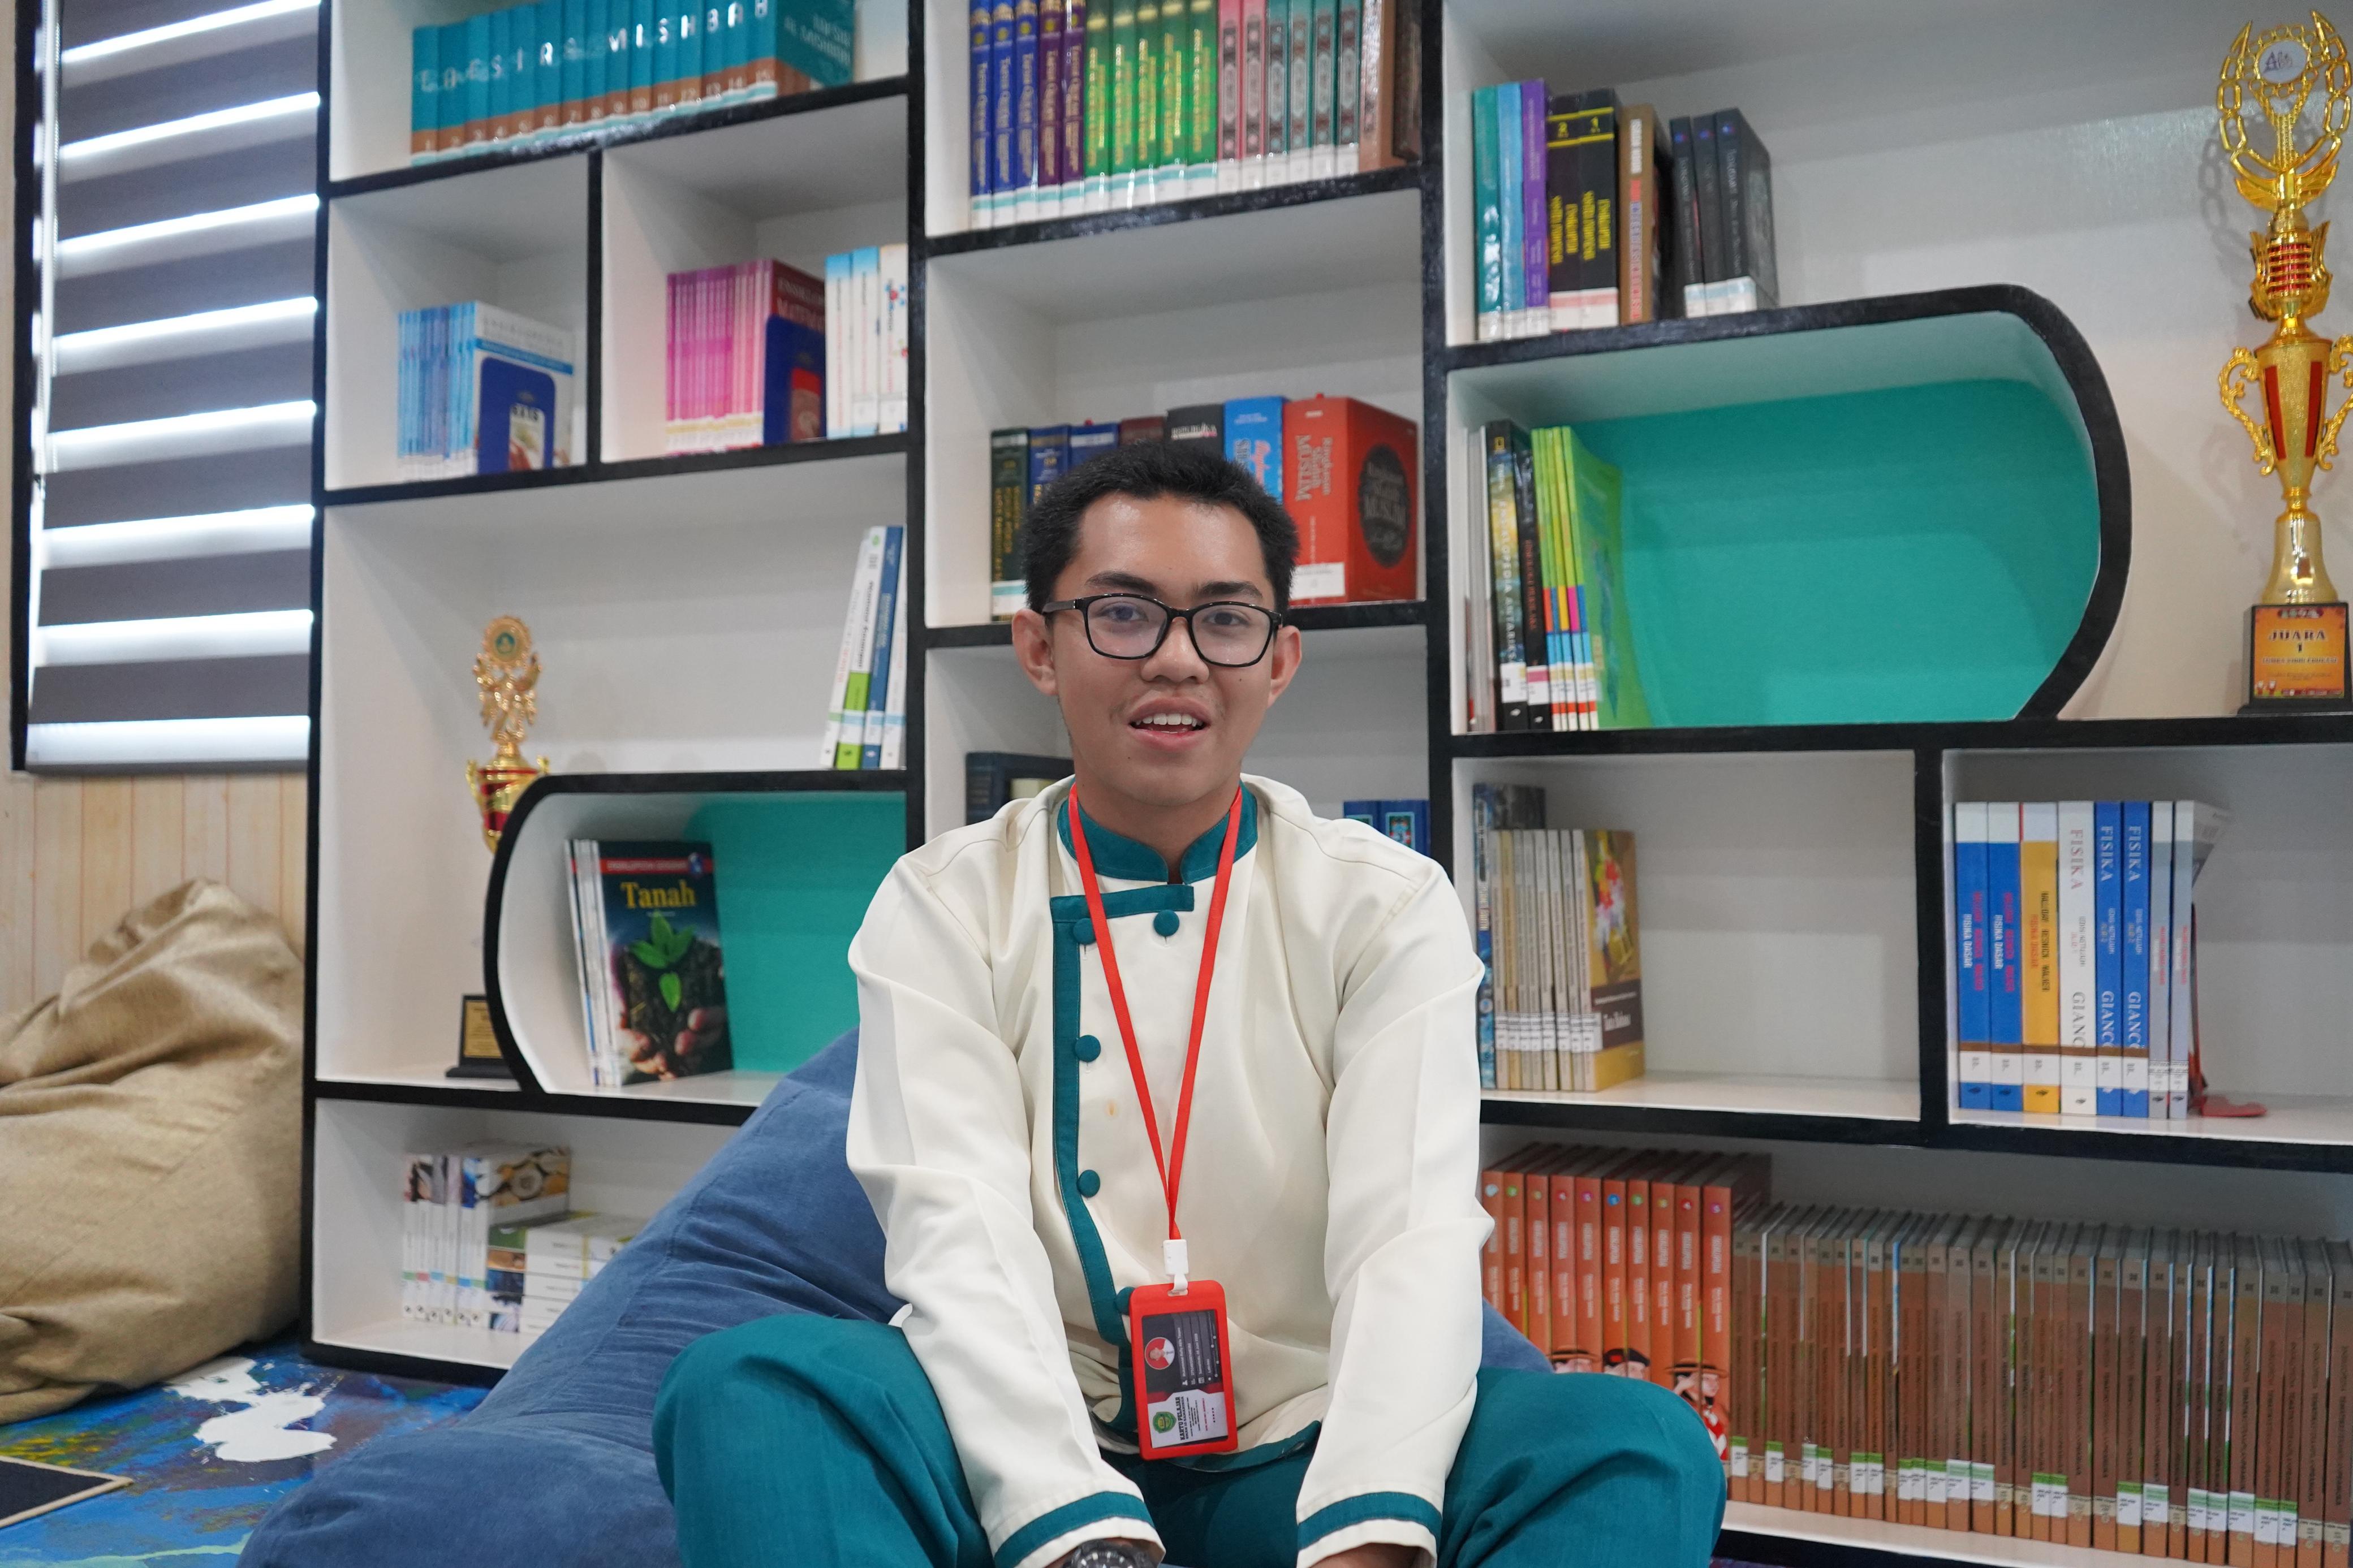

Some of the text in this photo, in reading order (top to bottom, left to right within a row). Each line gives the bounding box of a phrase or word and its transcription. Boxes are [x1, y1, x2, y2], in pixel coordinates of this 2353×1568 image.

[1296, 435, 1312, 500] MUSLIM
[2270, 629, 2326, 641] JUARA
[2071, 829, 2083, 890] FISIKA
[2101, 826, 2113, 882] FISIKA
[2128, 826, 2141, 882] FISIKA
[620, 880, 696, 908] Tanah
